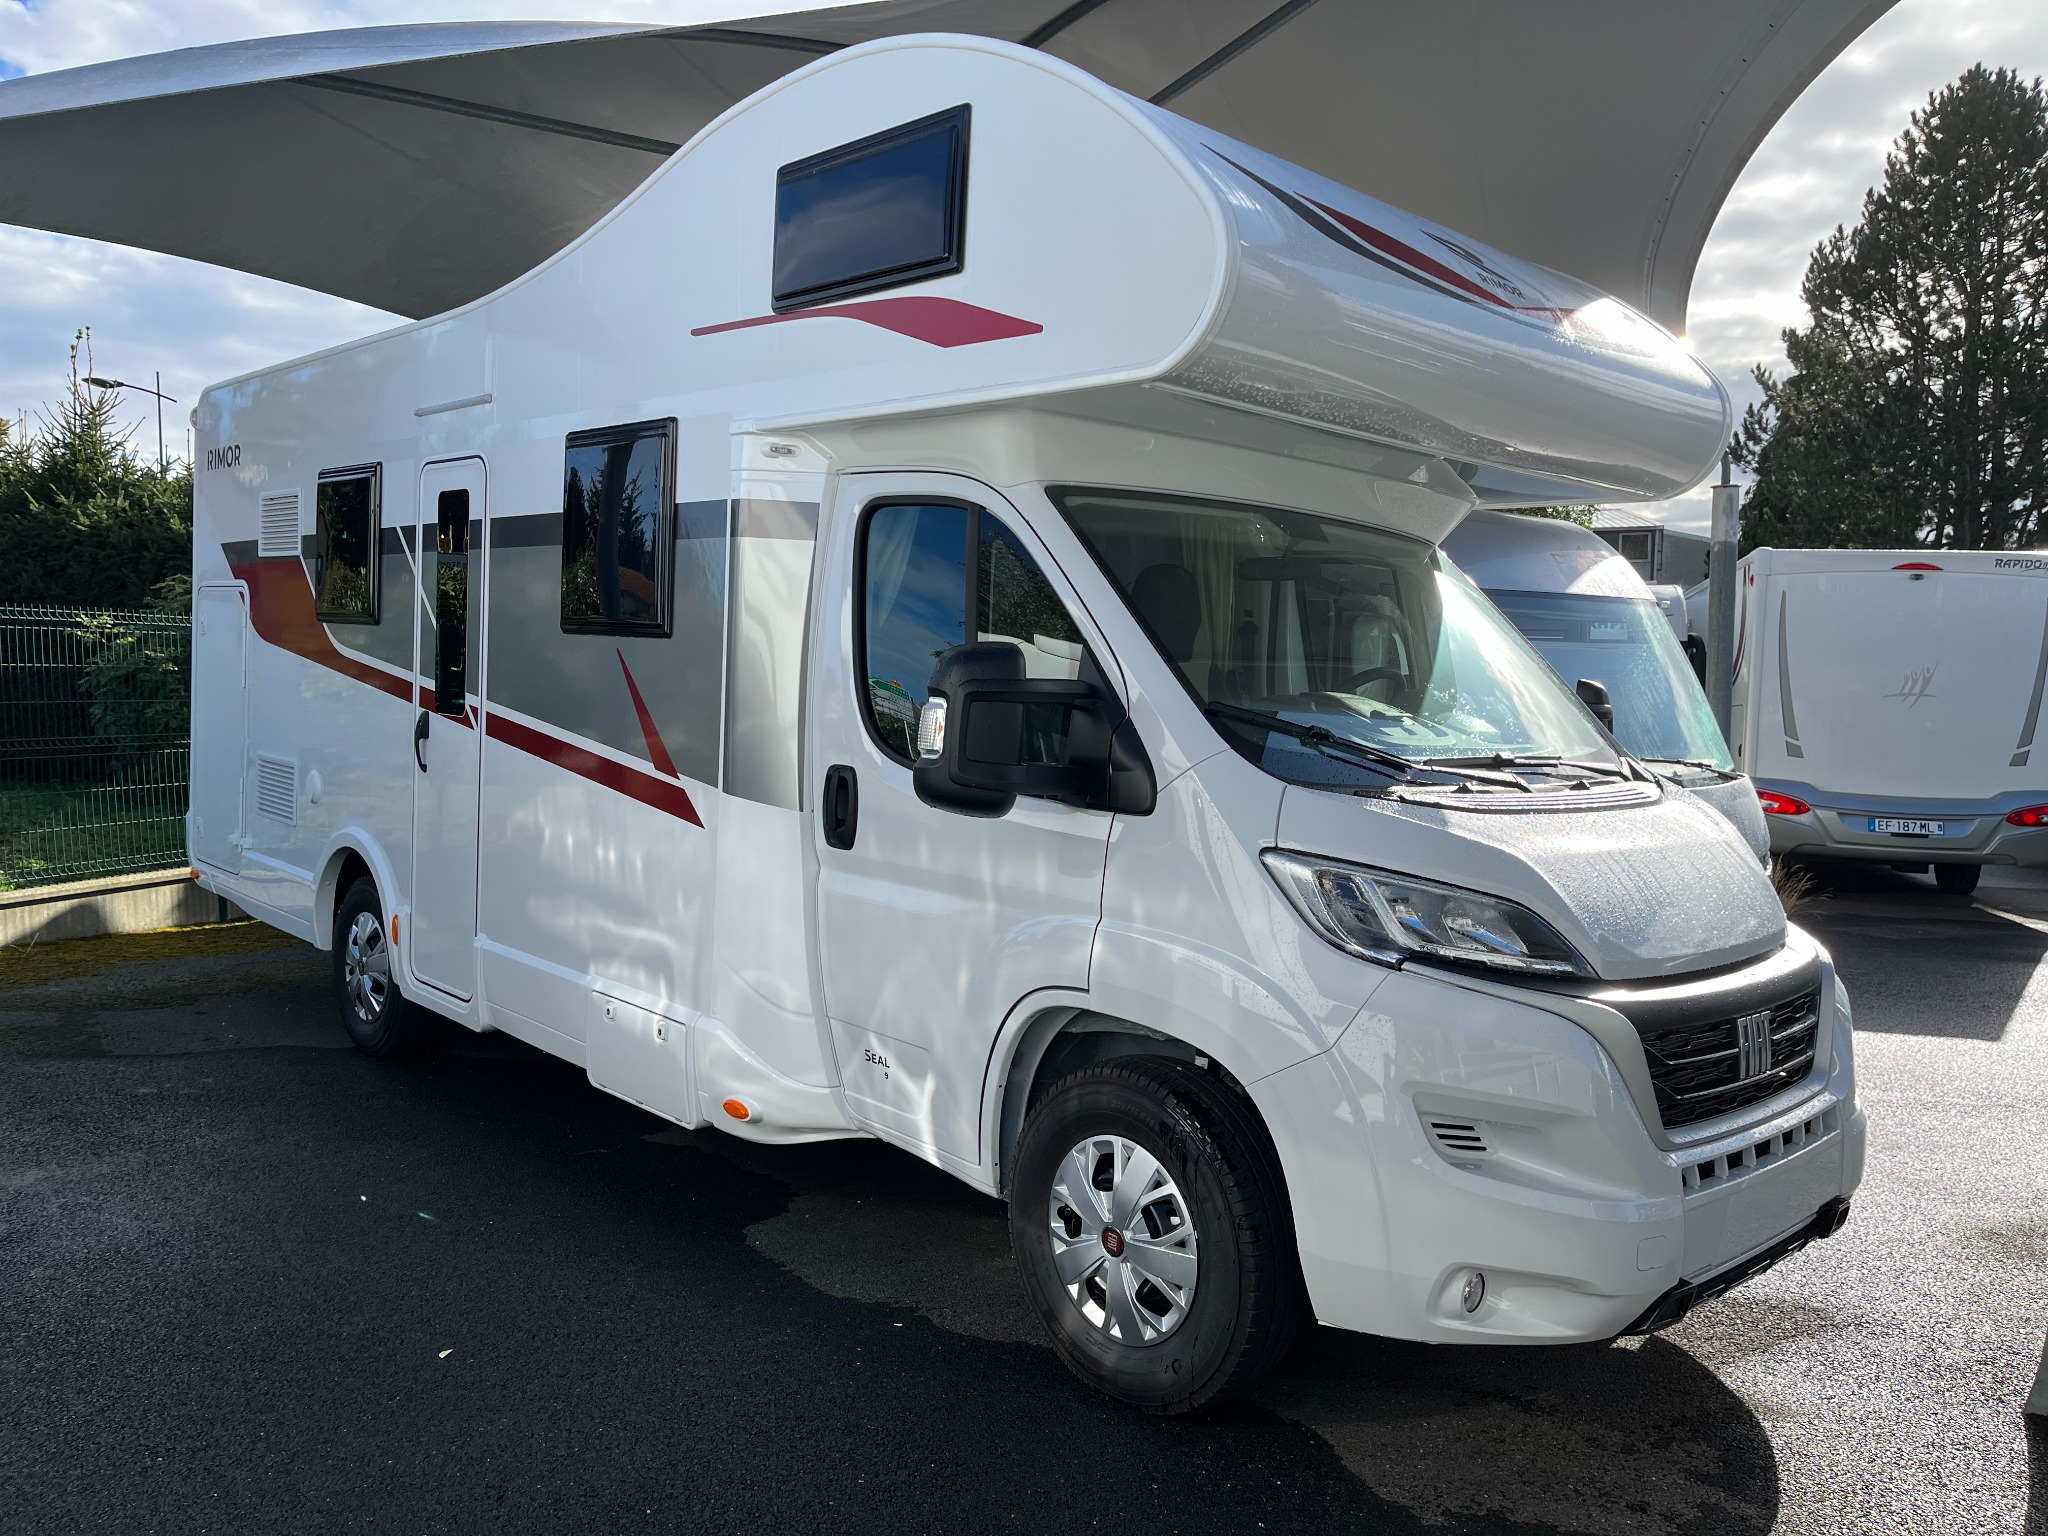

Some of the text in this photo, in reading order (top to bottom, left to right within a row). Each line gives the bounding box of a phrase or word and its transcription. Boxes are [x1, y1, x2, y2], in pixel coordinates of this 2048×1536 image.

[1476, 272, 1525, 300] RIMOR
[207, 444, 241, 471] RIMOR
[1877, 820, 1935, 833] EF-187-ML
[1737, 1010, 1771, 1079] FIAT
[864, 1048, 891, 1069] SEAL
[884, 1071, 889, 1080] 9
[1107, 1232, 1118, 1252] FIAT
